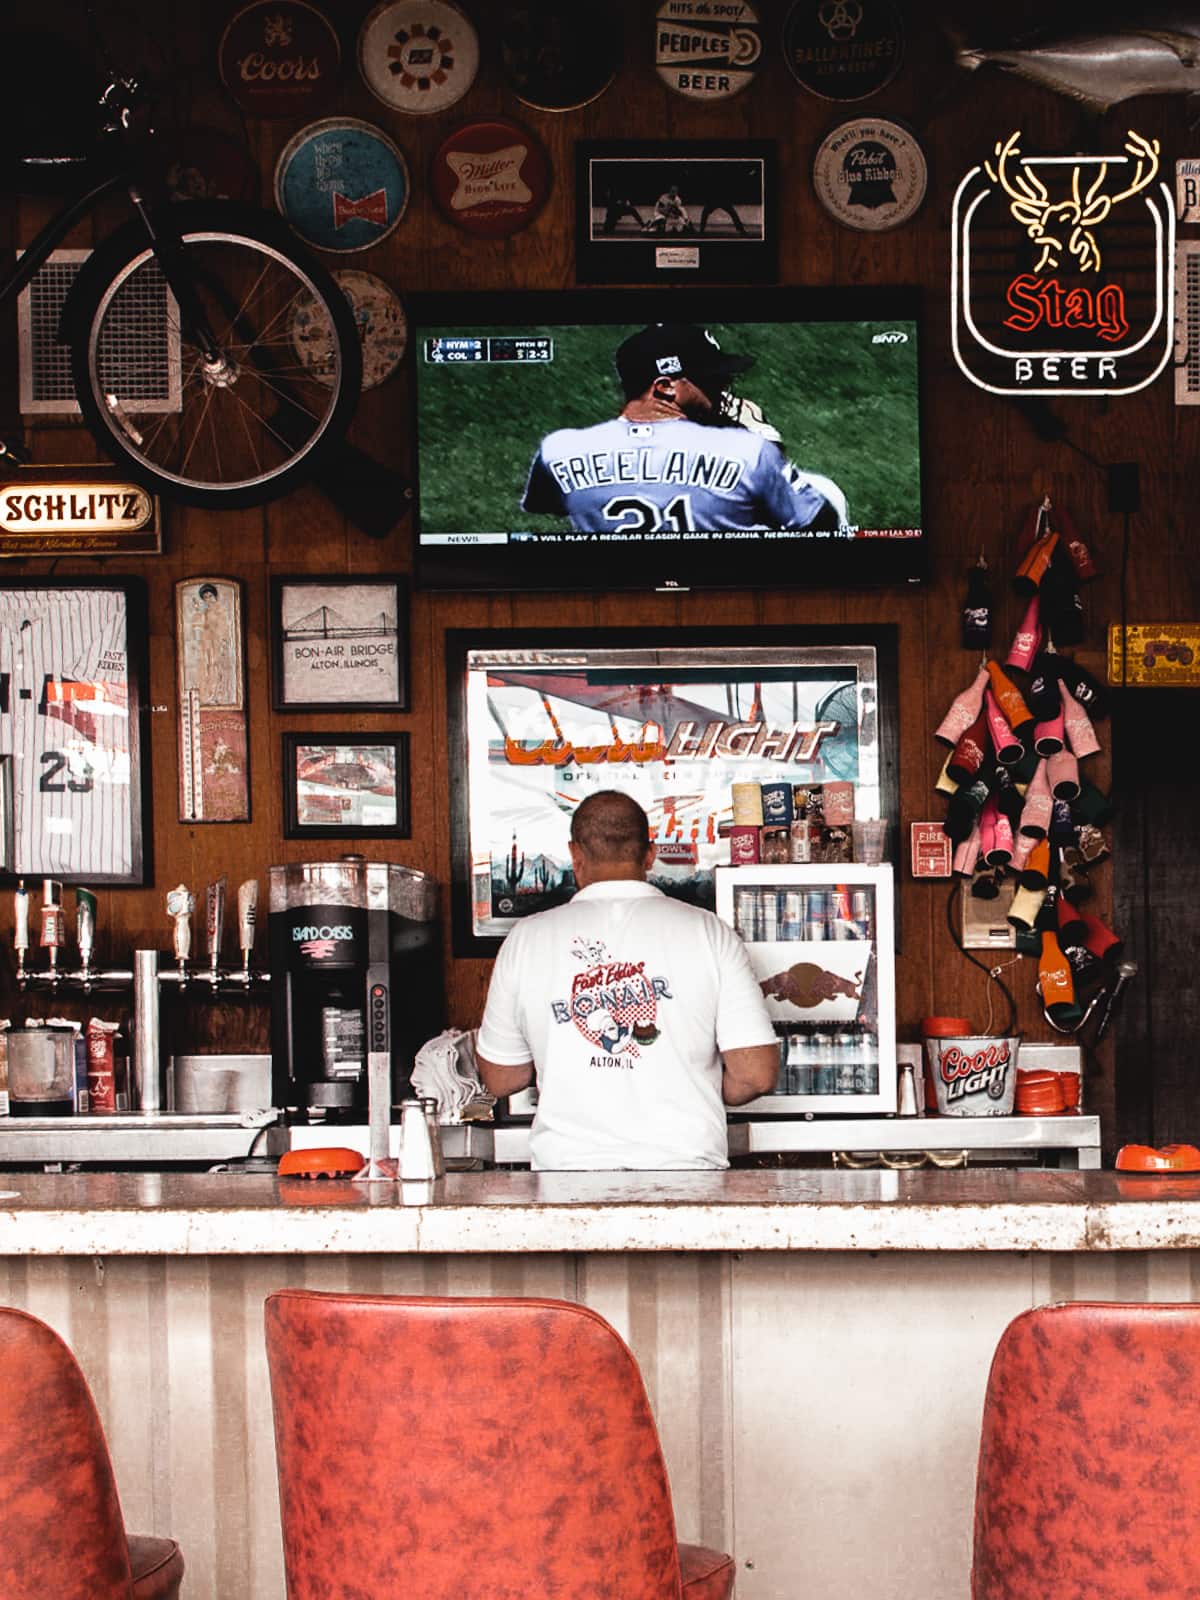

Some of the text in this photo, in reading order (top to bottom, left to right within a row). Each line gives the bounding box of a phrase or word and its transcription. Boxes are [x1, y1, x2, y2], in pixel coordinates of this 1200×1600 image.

[670, 3, 693, 14] HITS
[660, 32, 730, 52] PEOPLES
[237, 52, 321, 80] Coors
[678, 74, 730, 91] BEER
[850, 149, 889, 167] Pabst
[459, 159, 515, 179] Miller
[1003, 273, 1129, 342] Stag
[446, 341, 471, 350] NYM
[872, 331, 909, 344] SNY
[447, 352, 468, 360] COL
[1015, 357, 1118, 382] BEER
[550, 447, 746, 495] FREELAND
[6, 494, 141, 521] SCHLITZ
[815, 531, 831, 539] ON
[350, 643, 394, 656] BRIDGE
[343, 659, 379, 669] ILLINOIS
[666, 719, 842, 764] LIGHT
[919, 832, 945, 841] FIRE
[572, 971, 605, 995] Fast
[939, 1041, 1010, 1082] Coors
[948, 1062, 1009, 1102] LIGHT
